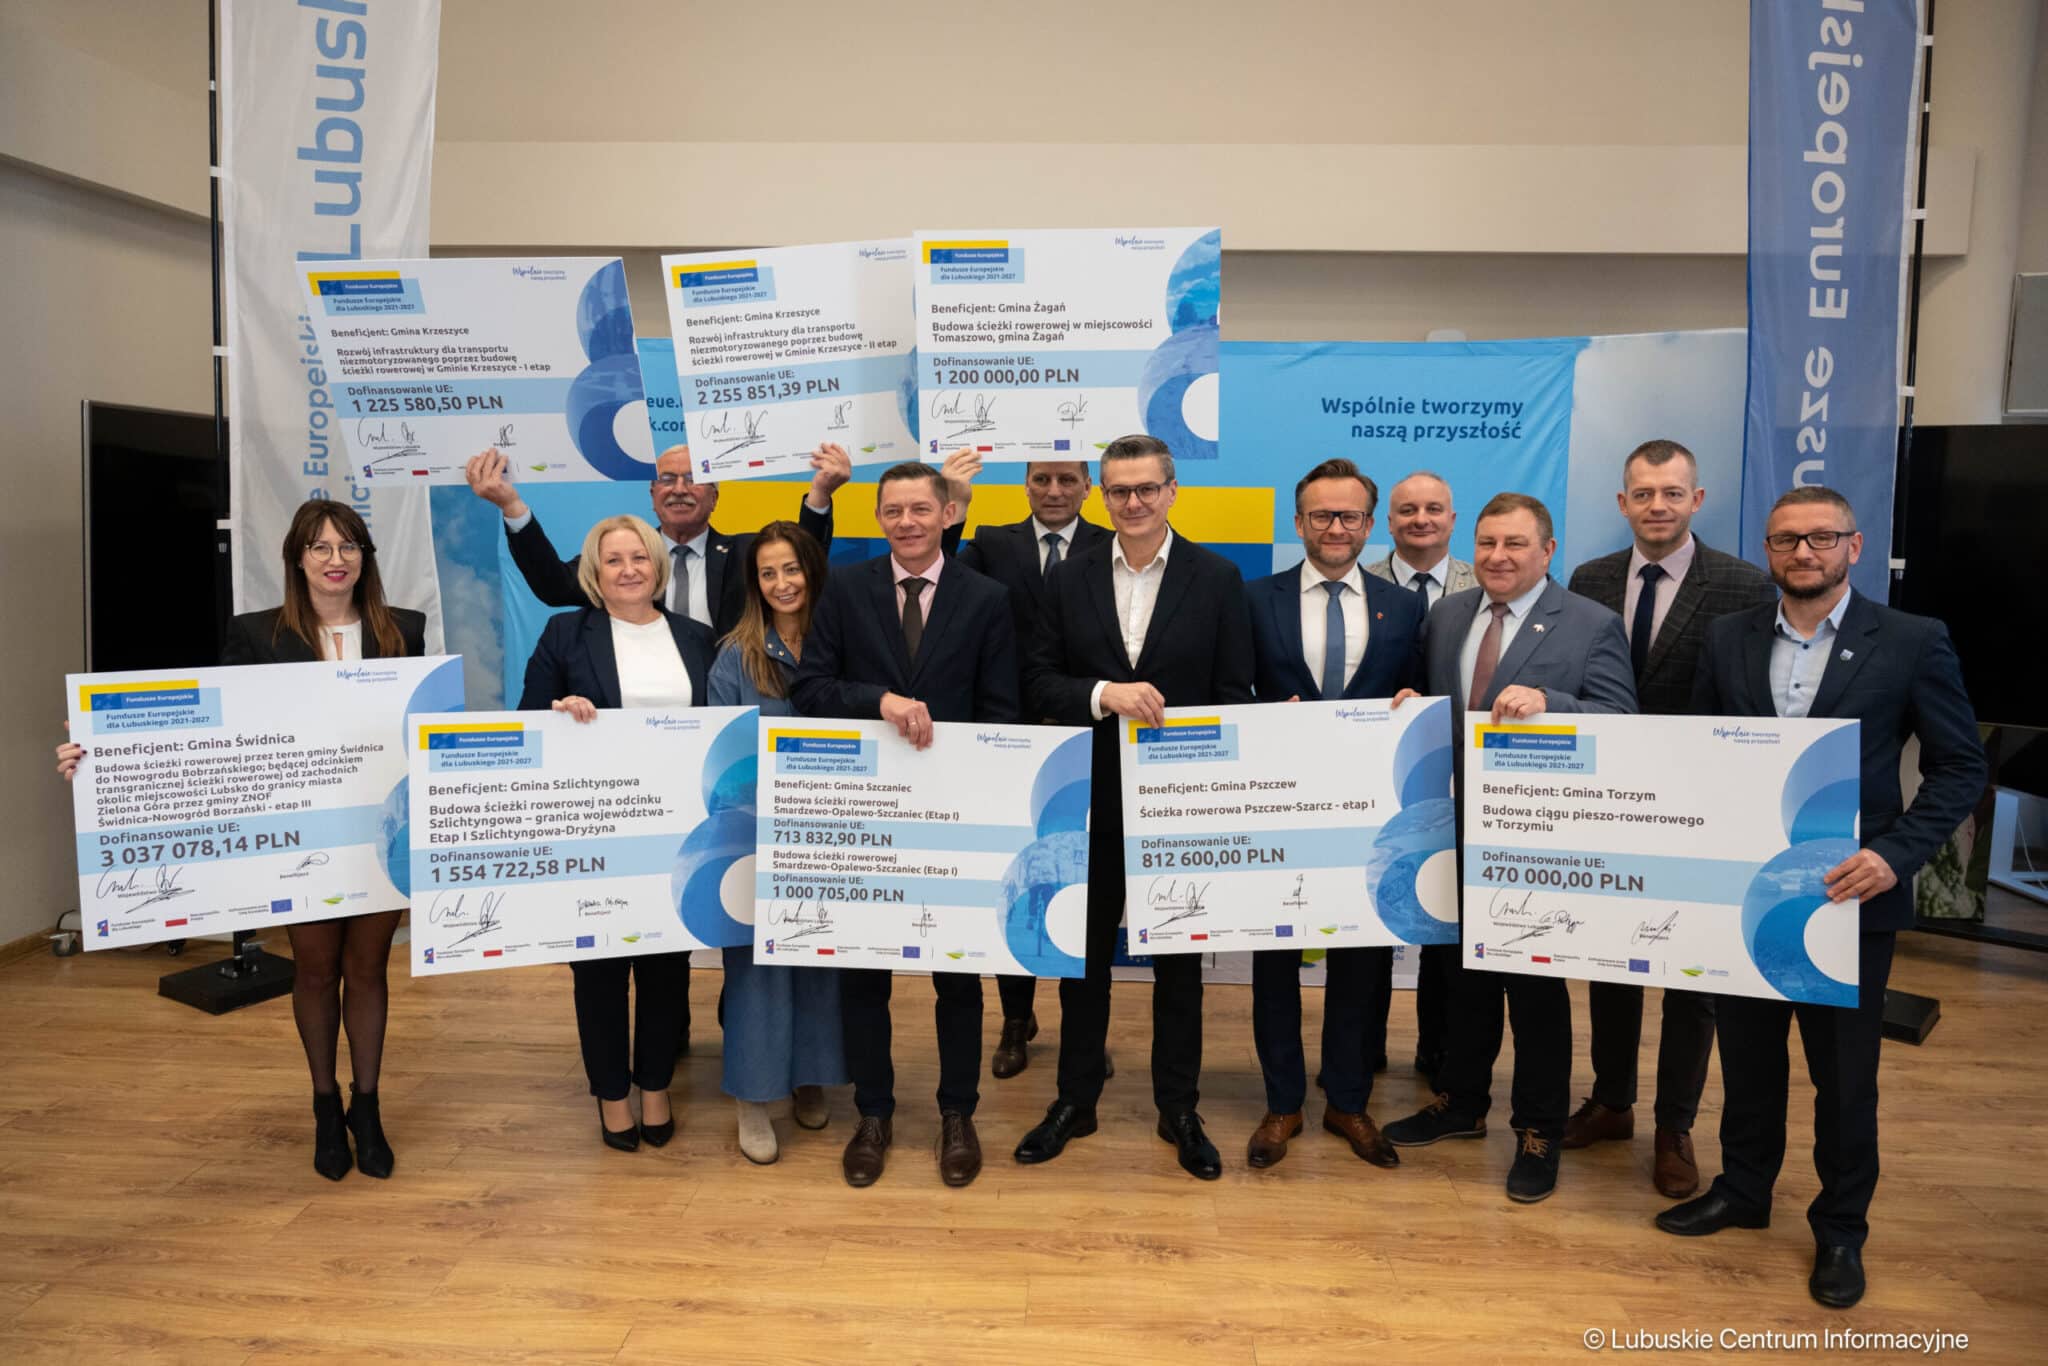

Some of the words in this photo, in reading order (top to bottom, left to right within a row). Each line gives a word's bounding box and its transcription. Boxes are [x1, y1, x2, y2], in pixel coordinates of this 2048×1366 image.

[932, 304, 996, 315] Beneficjent:
[998, 304, 1031, 313] Gmina
[1034, 302, 1066, 314] Żagań
[686, 315, 742, 327] Beneficjent:
[744, 312, 773, 322] Gmina
[775, 309, 820, 319] Krzeszyce
[932, 322, 974, 331] Budowa
[977, 321, 1012, 330] ścieżki
[1015, 320, 1070, 331] rowerowej
[1084, 320, 1152, 331] miejscowości
[331, 328, 389, 338] Beneficjent:
[390, 327, 421, 336] Gmina
[422, 327, 469, 336] Krzeszyce
[933, 334, 996, 343] Tomaszowo,
[998, 332, 1030, 343] gmina
[1032, 330, 1064, 343] Żagań
[933, 356, 1015, 366] Dofinansowanie
[1017, 356, 1034, 366] UE:
[935, 371, 942, 384] 1
[949, 370, 979, 384] 200
[984, 370, 1040, 386] 000,00
[1045, 369, 1079, 383] PLN
[698, 393, 708, 406] 2
[712, 389, 742, 404] 255
[747, 383, 801, 401] 851,39
[806, 379, 840, 394] PLN
[352, 401, 361, 413] 1
[367, 400, 399, 413] 225
[404, 398, 462, 413] 580,50
[466, 396, 503, 410] PLN
[1322, 397, 1415, 418] Wspólnie
[1422, 399, 1523, 418] tworzymy
[1352, 425, 1408, 442] naszą
[1414, 421, 1522, 442] przyszłość
[106, 712, 146, 720] Fundusze
[148, 709, 195, 718] Europejskie
[107, 721, 120, 729] dla
[122, 719, 169, 728] Lubuskiego
[171, 716, 210, 725] 2021-2027
[94, 742, 184, 758] Beneficjent:
[188, 738, 232, 751] Gmina
[236, 734, 295, 747] Świdnica
[95, 764, 140, 774] Budowa
[144, 758, 182, 770] ścieżki
[184, 754, 242, 767] rowerowej
[244, 754, 273, 764] przez
[276, 751, 304, 759] teren
[307, 747, 338, 759] gminy
[340, 743, 384, 754] Świdnica
[96, 775, 110, 784] do
[113, 770, 179, 783] Nowogrodu
[268, 758, 308, 772] będącej
[311, 756, 363, 767] odcinkiem
[96, 779, 184, 795] transgranicznej
[188, 776, 224, 787] ścieżki
[227, 770, 283, 784] rowerowej
[286, 769, 299, 779] od
[302, 764, 358, 777] zachodnich
[429, 783, 507, 796] Beneficjent:
[510, 780, 550, 792] Gmina
[553, 778, 640, 790] Szlichtyngowa
[774, 780, 832, 791] Beneficjent:
[834, 782, 864, 791] Gmina
[866, 783, 912, 792] Szczaniec
[1139, 782, 1208, 795] Beneficjent:
[1211, 781, 1246, 792] Gmina
[1249, 780, 1296, 790] Pszczew
[96, 794, 131, 805] okolic
[134, 787, 208, 802] miejscowości
[210, 784, 249, 795] Lubsko
[252, 782, 265, 791] do
[268, 779, 306, 792] granicy
[308, 776, 342, 786] miasta
[1483, 783, 1559, 798] Beneficjent:
[1563, 787, 1603, 799] Gmina
[1607, 789, 1656, 803] Torzym
[97, 805, 140, 816] Zielona
[143, 801, 170, 812] Góra
[173, 800, 203, 811] przez
[206, 795, 239, 808] gminy
[241, 791, 271, 803] ZNOF
[430, 804, 481, 815] Budowa
[484, 800, 527, 812] ścieżki
[530, 797, 595, 810] rowerowej
[598, 799, 612, 807] na
[616, 794, 661, 806] odcinku
[774, 795, 812, 805] Budowa
[814, 796, 846, 806] ścieżki
[849, 799, 898, 809] rowerowej
[1140, 806, 1183, 818] Ścieżka
[1186, 806, 1242, 816] rowerowa
[1245, 802, 1332, 814] Pszczew-Szarcz
[1342, 800, 1369, 811] etap
[98, 808, 210, 827] Świdnica-Nowogród
[213, 802, 266, 816] Borzański
[275, 802, 299, 811] etap
[301, 798, 311, 808] III
[430, 816, 522, 829] Szlichtyngowa
[536, 811, 580, 825] granica
[583, 808, 664, 822] województwa
[774, 806, 922, 818] Smardzewo-Opalewo-Szczaniec
[925, 810, 950, 821] (Etap
[1483, 804, 1532, 817] Budowa
[1536, 807, 1569, 821] ciągu
[1573, 808, 1704, 828] pieszo-rowerowego
[774, 818, 848, 829] Dofinansowanie
[850, 821, 864, 830] UE:
[1483, 821, 1493, 829] w
[1496, 819, 1554, 833] Torzymiu
[430, 834, 459, 844] Etap
[471, 823, 616, 841] Szlichtyngowa-Dryżyna
[775, 832, 801, 845] 713
[806, 833, 856, 848] 832,90
[861, 834, 892, 847] PLN
[101, 851, 114, 868] 3
[122, 846, 164, 865] 037
[172, 836, 248, 860] 078,14
[256, 831, 300, 850] PLN
[430, 847, 530, 863] Dofinansowanie
[533, 846, 552, 857] UE:
[1143, 853, 1175, 868] 812
[1181, 850, 1241, 868] 600,00
[1247, 848, 1284, 864] PLN
[1483, 850, 1581, 867] Dofinansowanie
[1585, 857, 1605, 869] UE:
[432, 869, 440, 884] 1
[449, 866, 486, 883] 554
[493, 860, 559, 880] 722,58
[566, 857, 605, 874] PLN
[1482, 866, 1519, 883] 470
[1525, 869, 1593, 889] 000,00
[1600, 874, 1643, 892] PLN
[774, 886, 780, 899] 1
[786, 887, 814, 900] 000
[818, 888, 868, 903] 705,00
[873, 889, 904, 902] PLN
